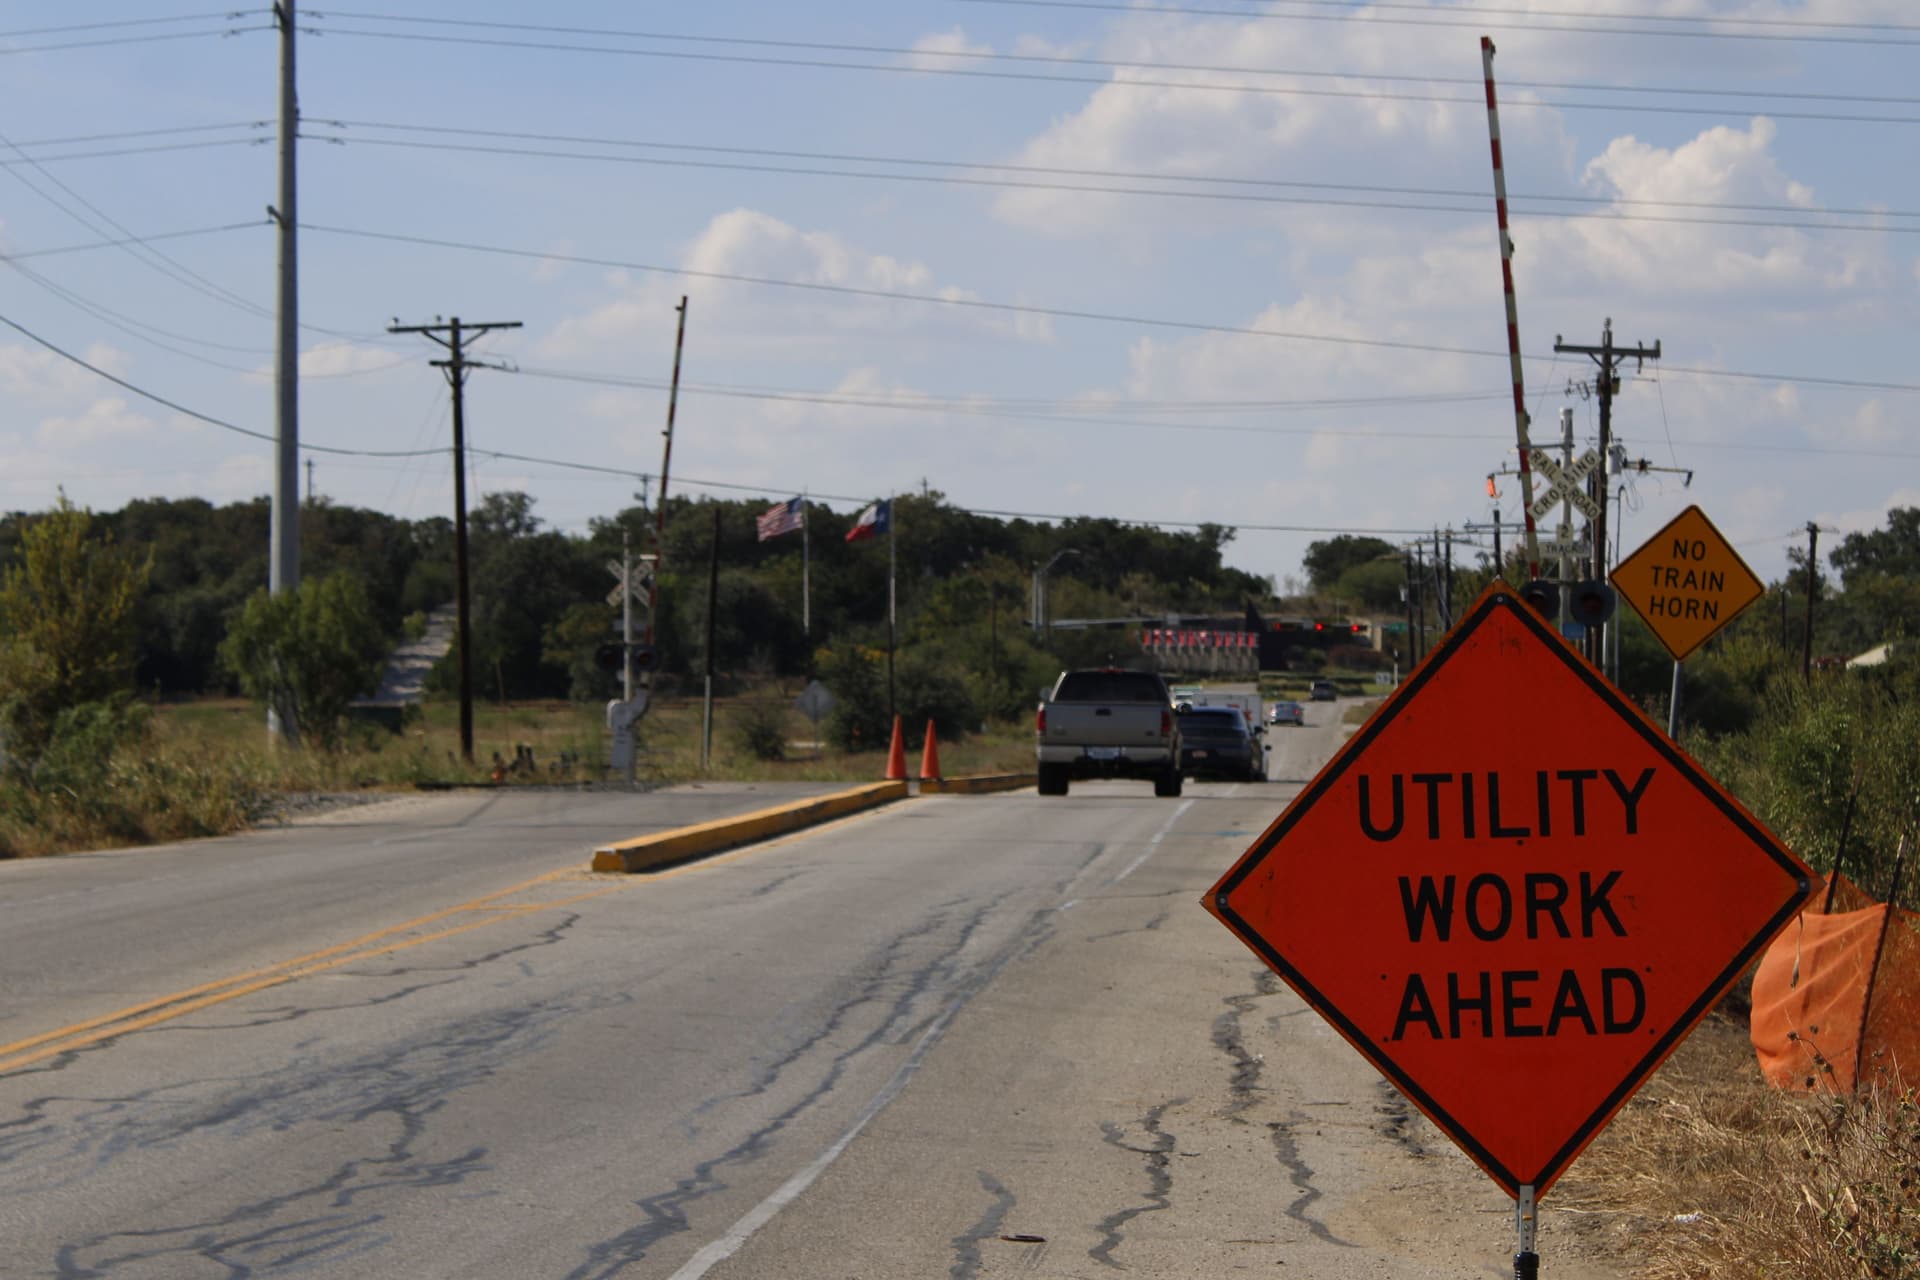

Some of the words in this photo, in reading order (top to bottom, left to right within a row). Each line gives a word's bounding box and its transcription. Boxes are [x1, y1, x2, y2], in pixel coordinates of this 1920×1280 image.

[1533, 454, 1596, 516] CROSSING
[1561, 525, 1569, 538] 2
[1672, 538, 1707, 562] NO
[1651, 564, 1725, 593] TRAIN
[1649, 594, 1719, 622] HORN
[1358, 768, 1656, 841] UTILITY
[1398, 871, 1627, 942] WORK
[1392, 968, 1646, 1040] AHEAD
